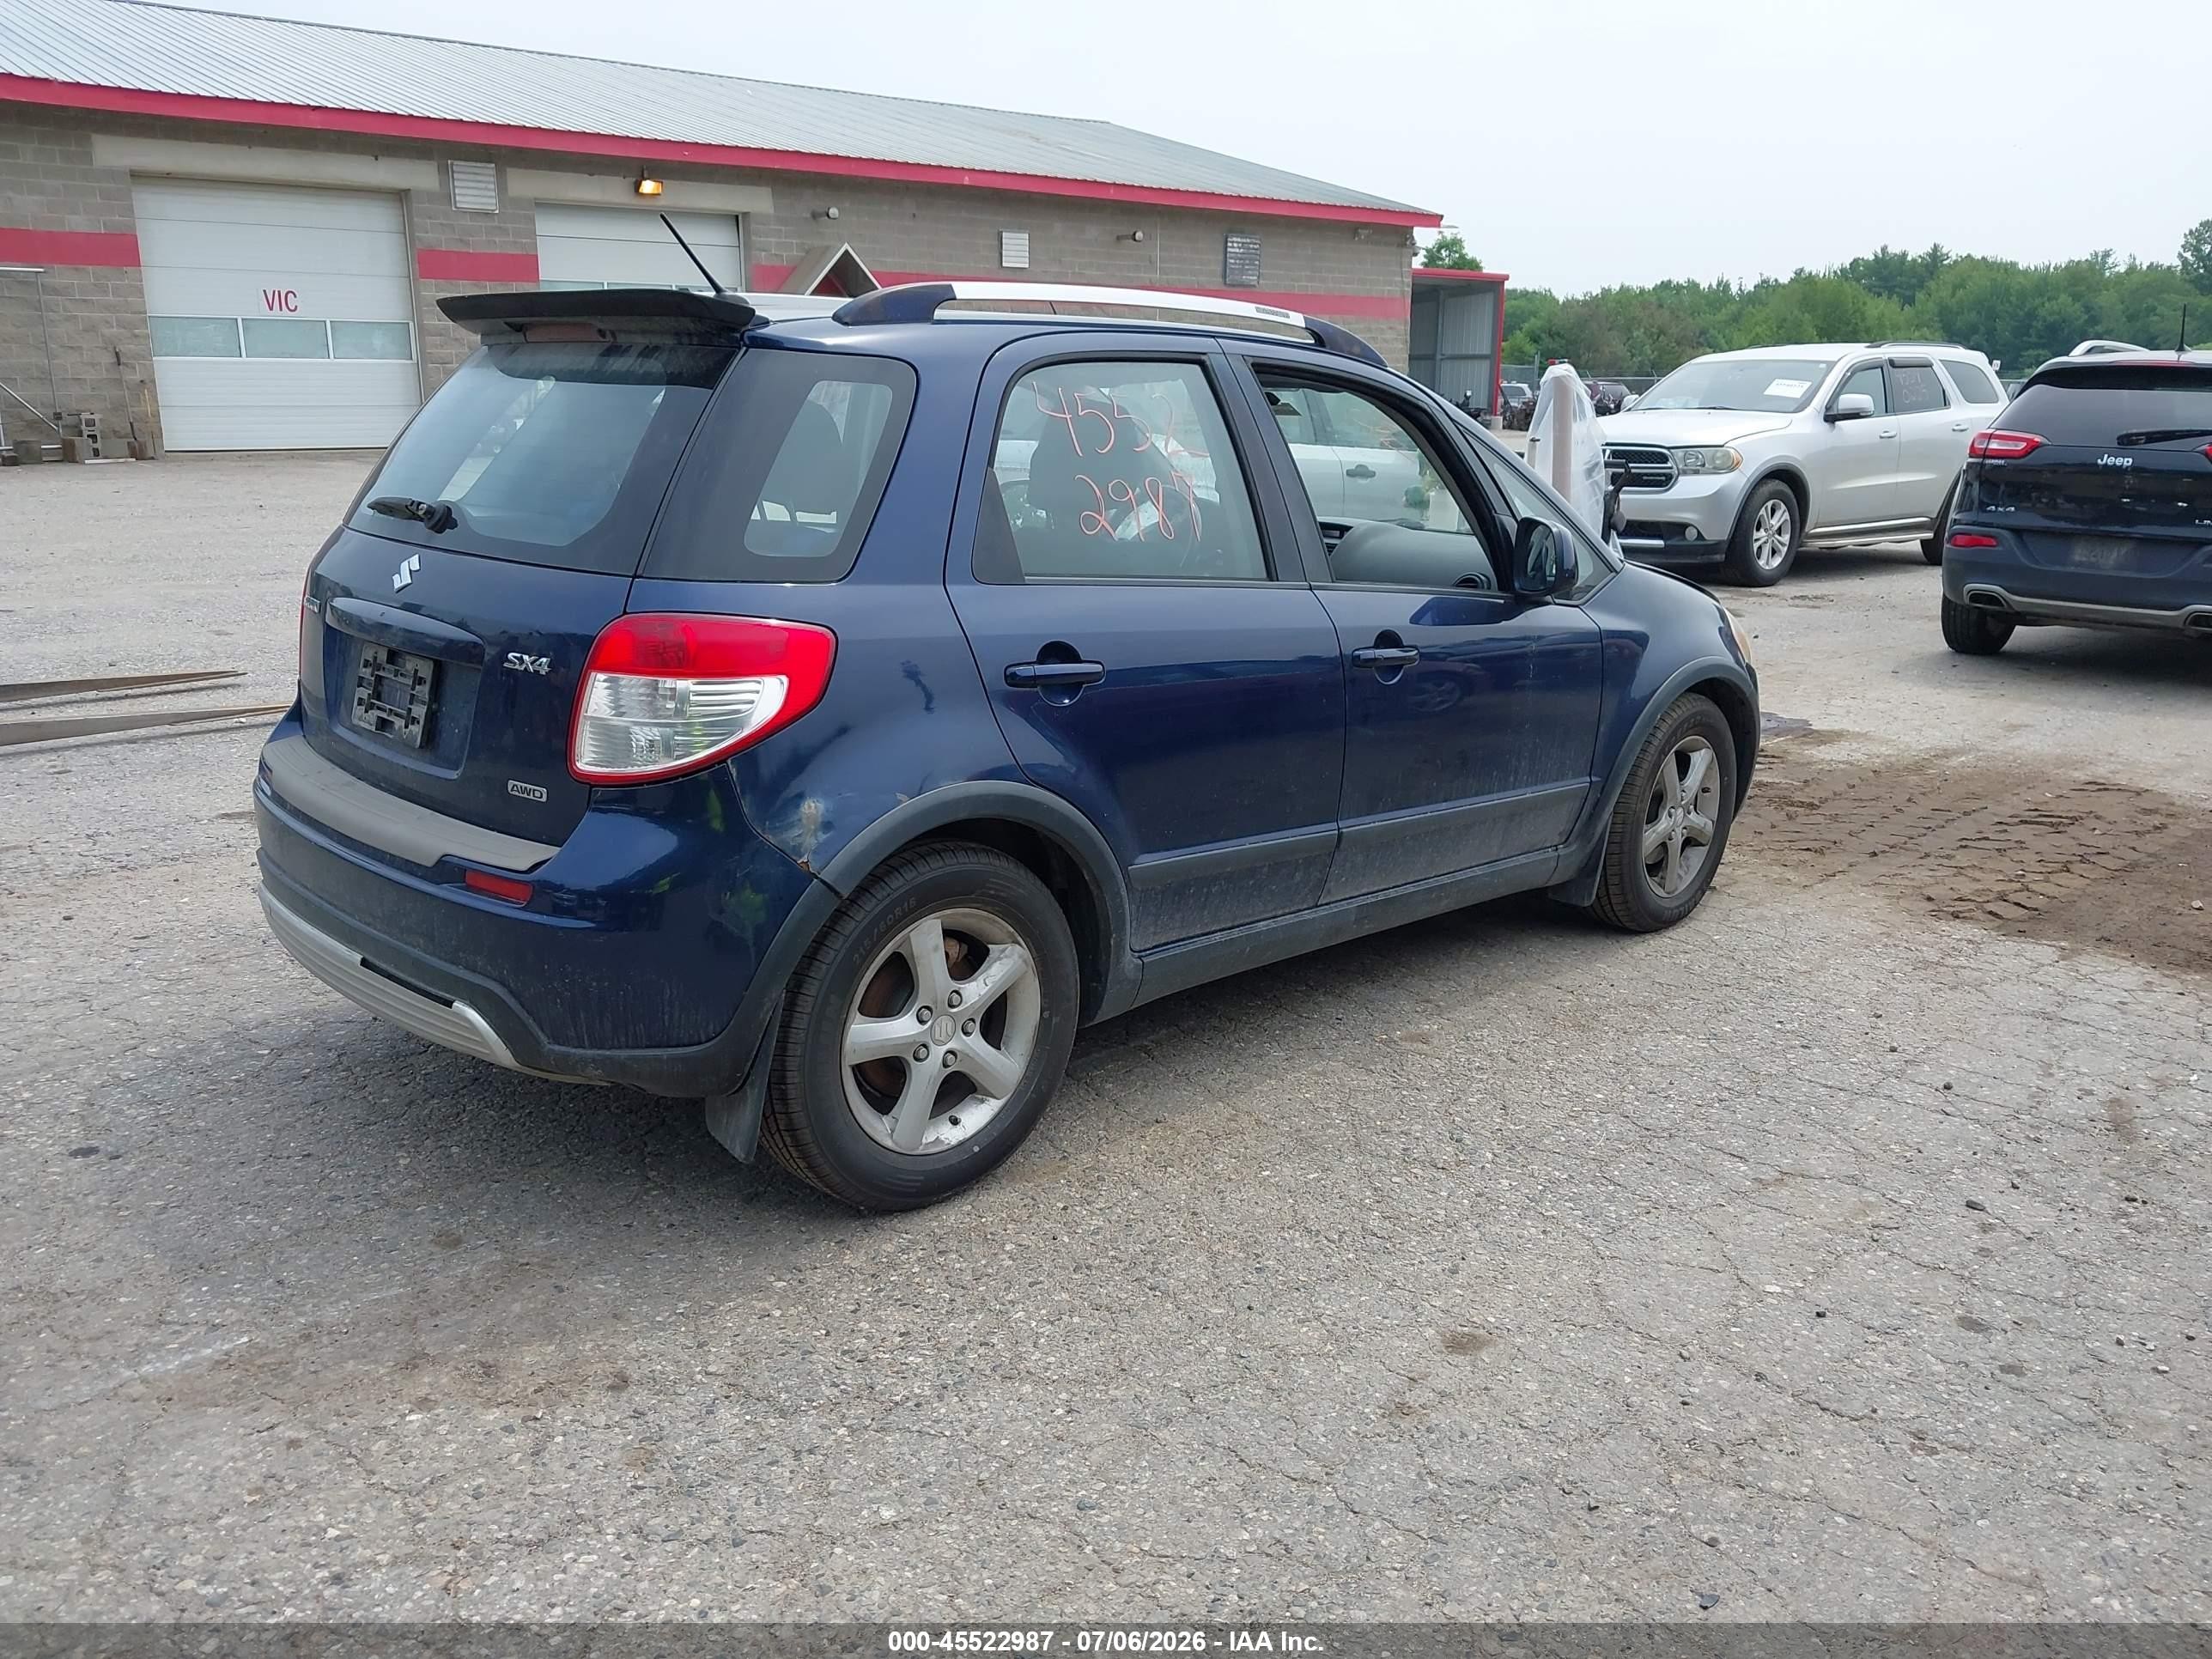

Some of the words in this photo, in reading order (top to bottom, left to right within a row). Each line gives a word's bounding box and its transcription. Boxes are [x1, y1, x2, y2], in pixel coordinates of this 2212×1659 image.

[263, 289, 298, 313] VIC
[1032, 381, 1210, 458] 4552
[2097, 453, 2134, 470] Jeep
[1075, 470, 1200, 543] 2987
[502, 652, 552, 676] SX4
[510, 783, 544, 799] AWD
